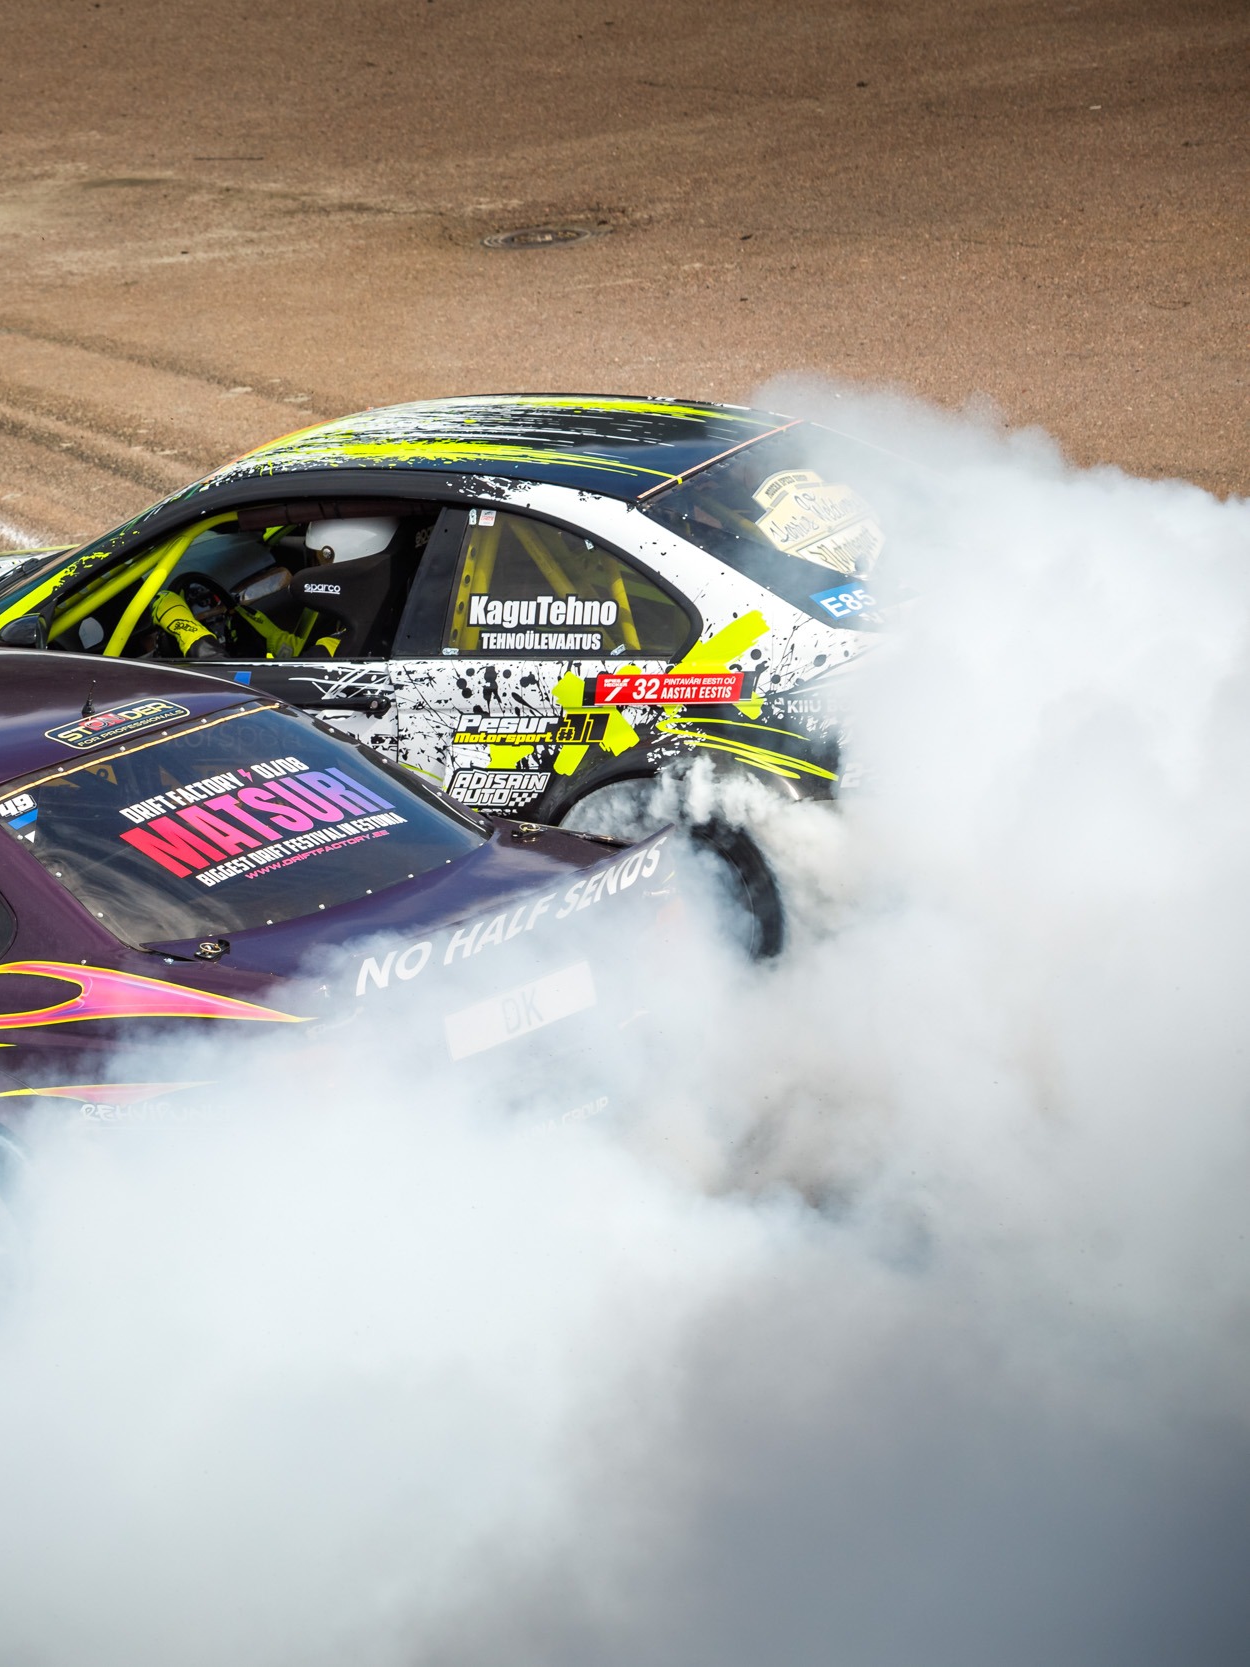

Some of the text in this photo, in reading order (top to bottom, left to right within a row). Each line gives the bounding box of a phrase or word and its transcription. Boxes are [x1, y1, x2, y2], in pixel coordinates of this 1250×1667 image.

[304, 584, 341, 595] sparco
[469, 596, 618, 629] KaguTehno
[820, 589, 877, 618] E85
[481, 631, 601, 650] TEHNOÜLEVAATUS
[632, 678, 660, 700] 32
[663, 677, 701, 686] PINTAVÄRI
[702, 677, 723, 685] EESTI
[661, 686, 733, 700] AASTAT EESTIS
[57, 702, 174, 742] STONDER
[77, 736, 101, 747] FOR
[100, 709, 185, 739] PROFESSIONALS
[457, 714, 560, 734] Pesur
[453, 731, 553, 745] Motorsport
[119, 756, 310, 824] DRIFT FACTORY 01/08
[453, 771, 547, 791] ADISAIN
[450, 788, 511, 806] AUTO
[119, 767, 397, 879] MATSURI
[195, 811, 408, 888] BIGGEST DRIFT FESTIVAL IN ESTONIA
[355, 836, 668, 997] NO HALF SENDS
